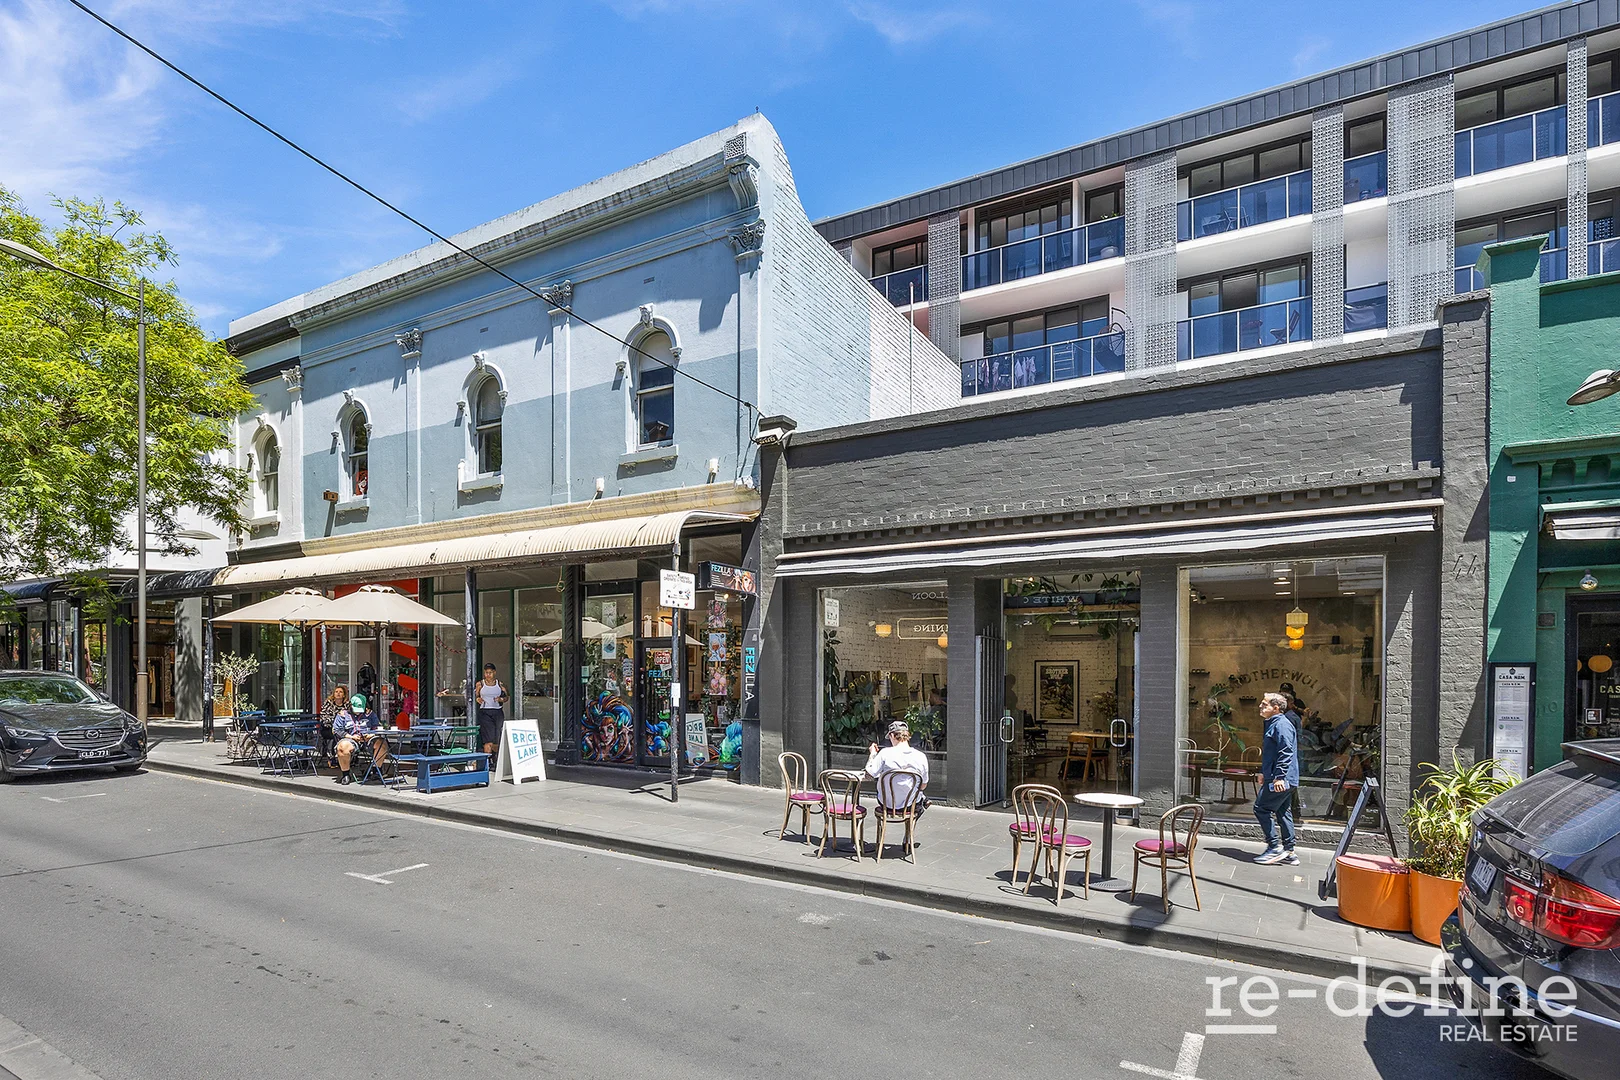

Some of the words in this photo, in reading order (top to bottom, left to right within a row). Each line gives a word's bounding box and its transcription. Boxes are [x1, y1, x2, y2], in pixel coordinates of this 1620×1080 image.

[711, 564, 731, 575] FEZILLA
[745, 647, 755, 701] FEZILLA
[517, 746, 538, 760] LANE
